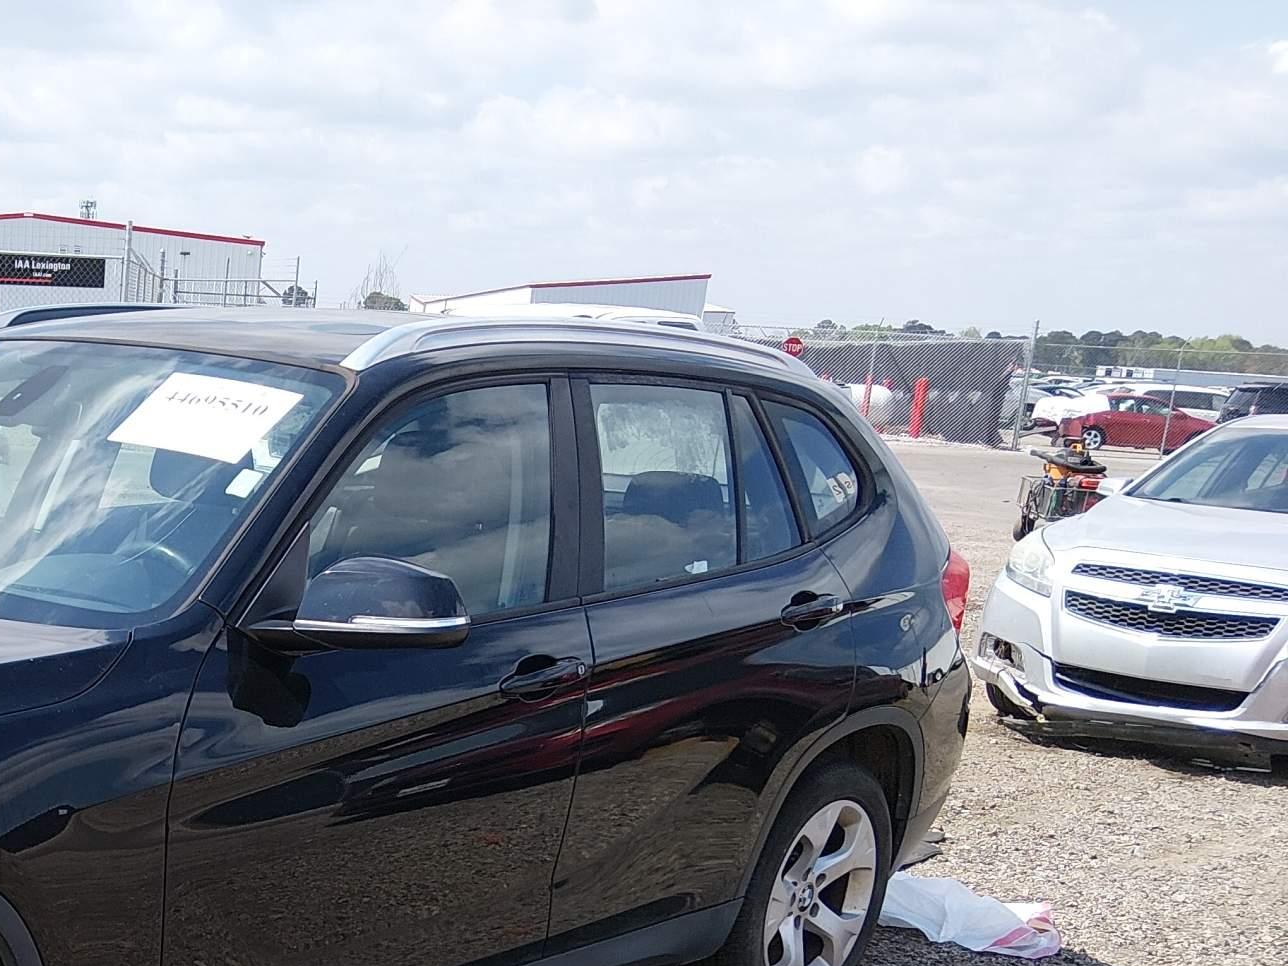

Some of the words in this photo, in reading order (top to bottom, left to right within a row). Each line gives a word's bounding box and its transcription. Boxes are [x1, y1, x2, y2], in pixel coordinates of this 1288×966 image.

[14, 259, 30, 269] IAA
[31, 259, 71, 272] Lexington
[783, 343, 803, 352] STOP
